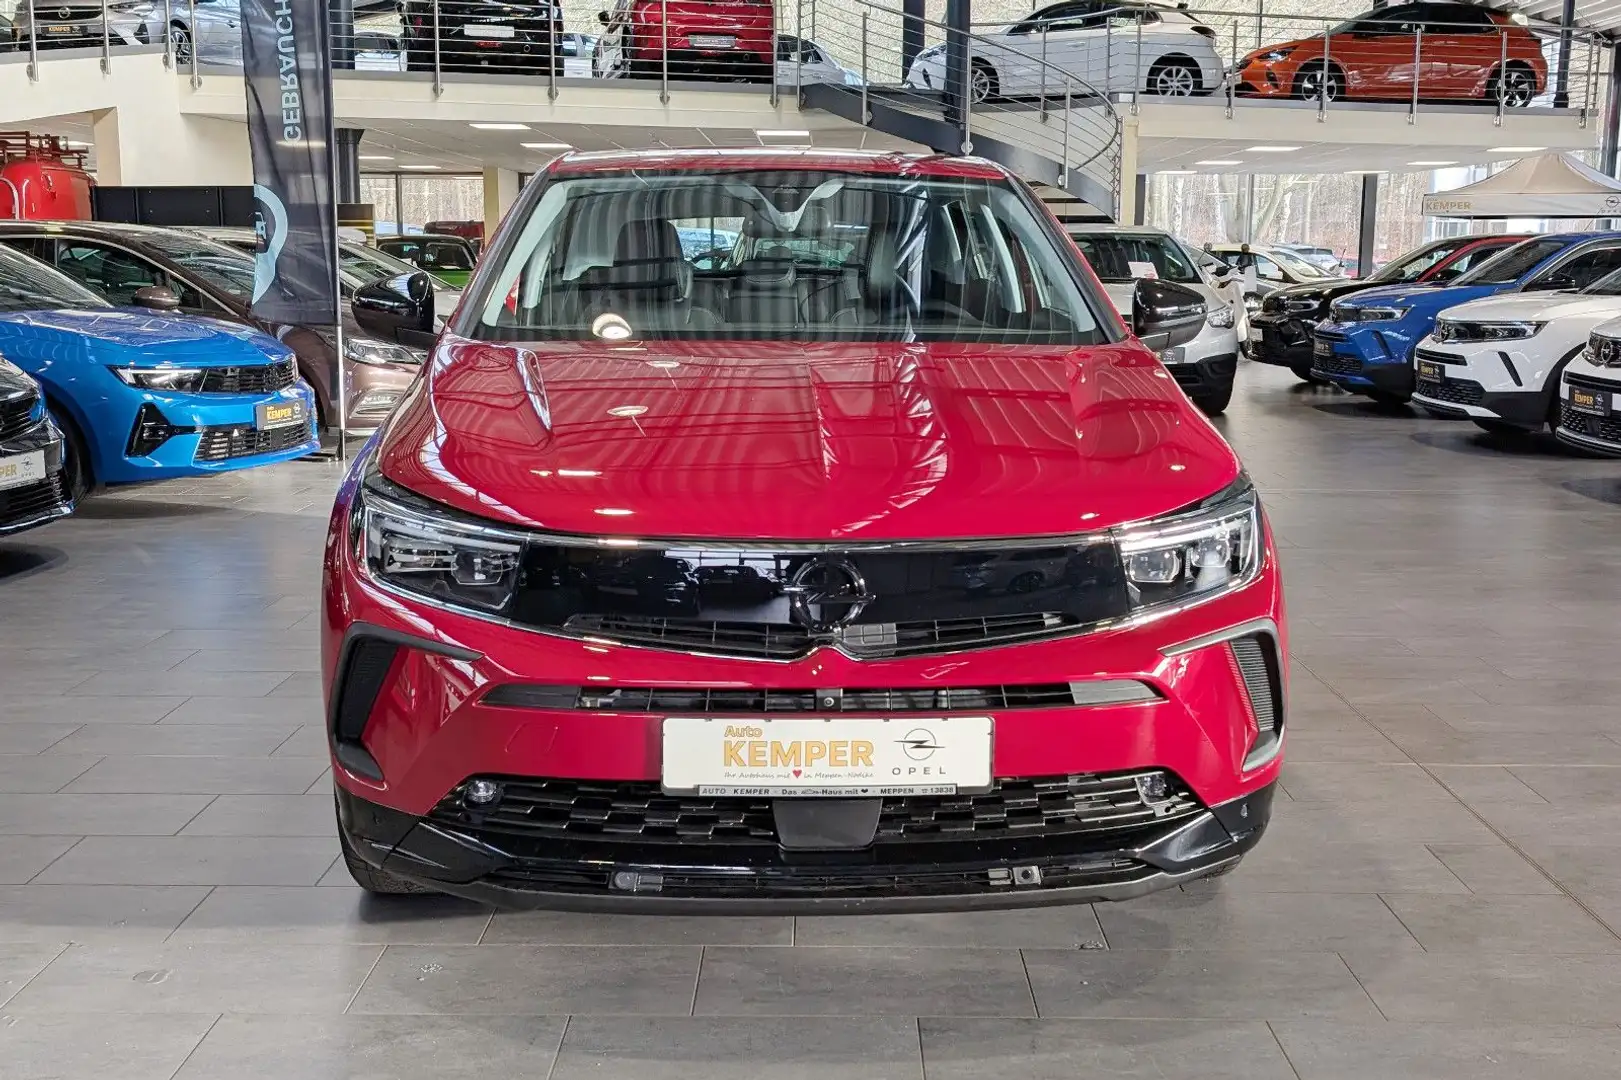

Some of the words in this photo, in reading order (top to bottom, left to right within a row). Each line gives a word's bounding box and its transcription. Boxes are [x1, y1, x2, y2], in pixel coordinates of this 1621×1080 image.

[1425, 200, 1471, 210] KEMPER
[267, 408, 292, 420] KEMPER
[724, 725, 763, 737] Auto
[723, 740, 875, 767] KEMPER
[891, 766, 946, 775] OPEL
